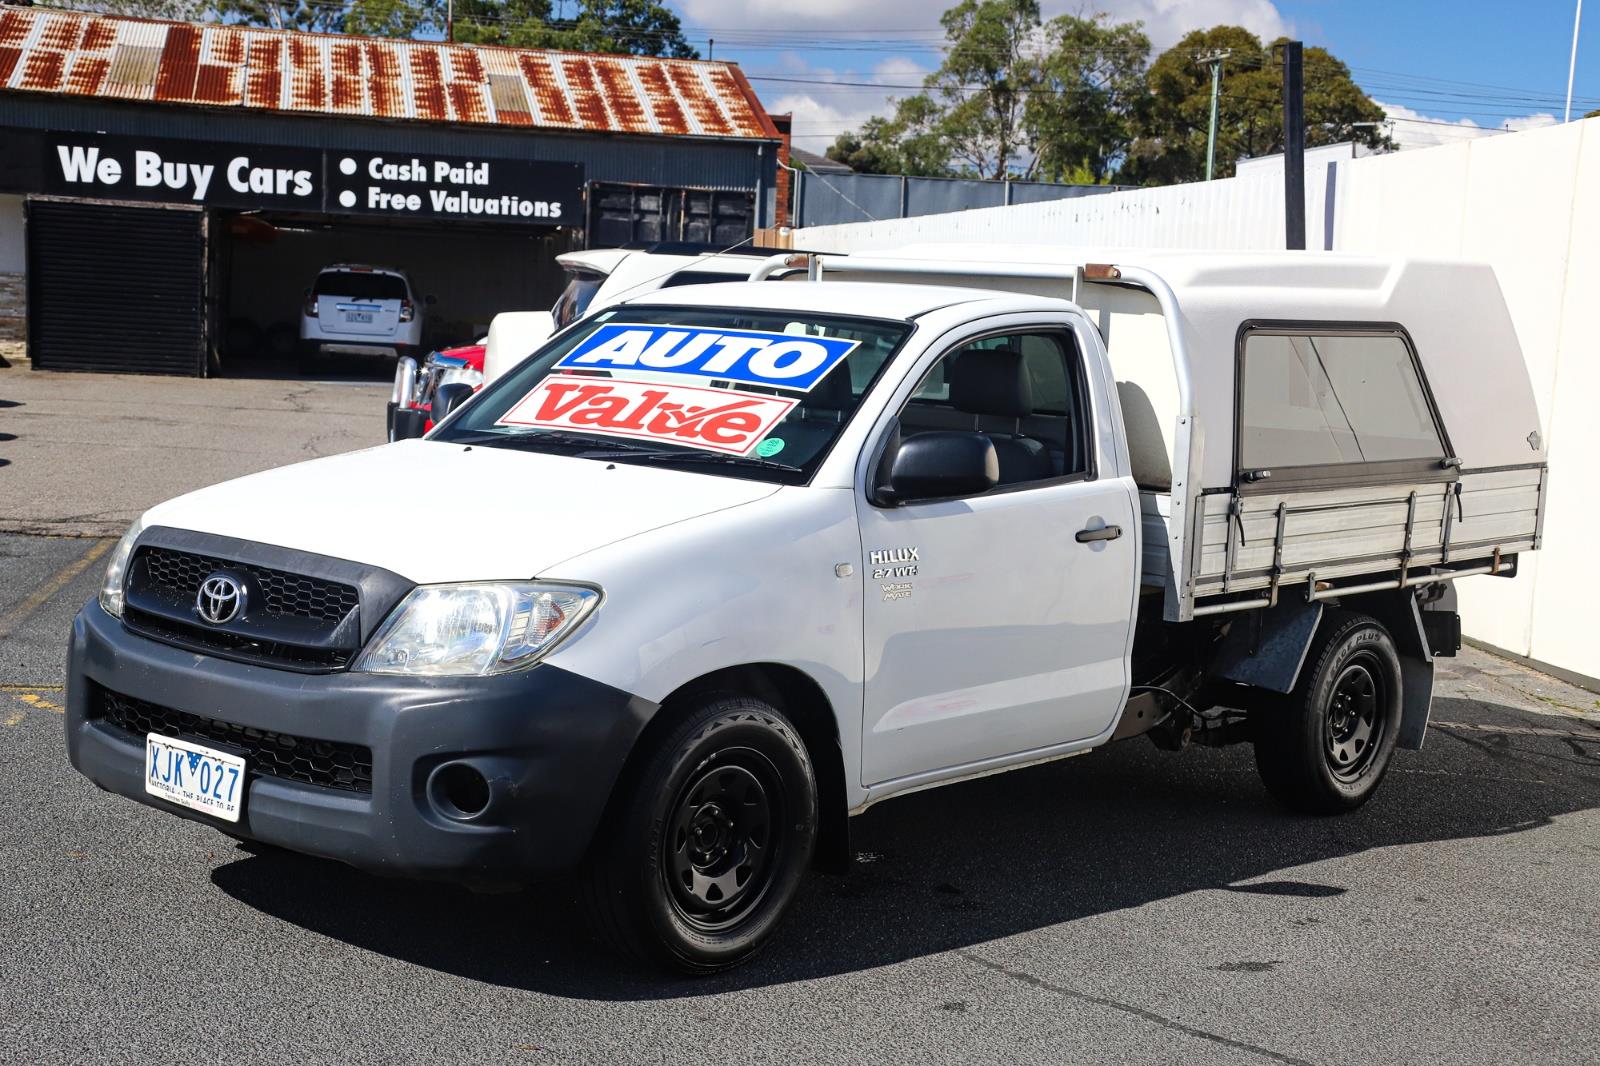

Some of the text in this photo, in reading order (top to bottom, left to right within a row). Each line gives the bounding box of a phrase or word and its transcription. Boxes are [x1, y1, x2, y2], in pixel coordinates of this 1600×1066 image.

[57, 145, 313, 200] We Buy Cars
[368, 157, 489, 185] Cash Paid
[367, 187, 562, 218] Free Valuations
[573, 330, 828, 379] AUTO
[534, 383, 764, 444] Value
[869, 547, 920, 565] HILUX
[151, 745, 239, 802] XJK 027
